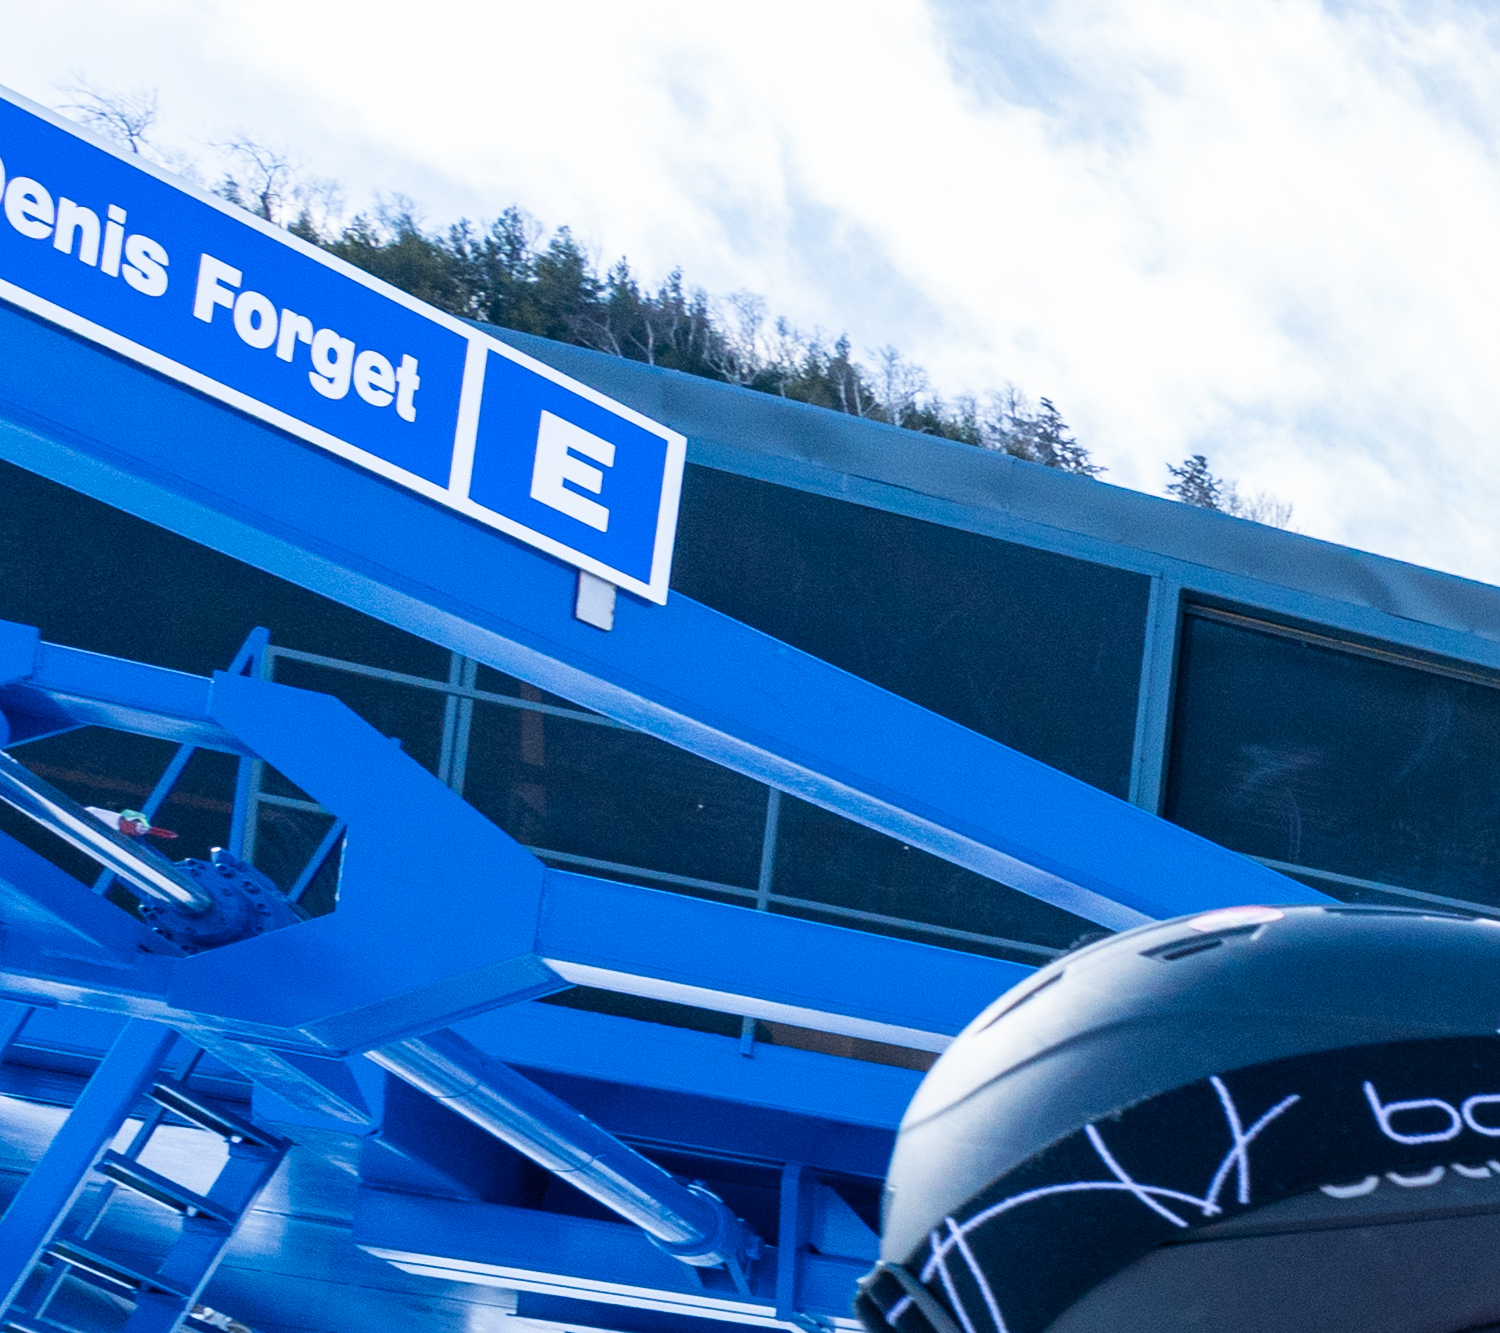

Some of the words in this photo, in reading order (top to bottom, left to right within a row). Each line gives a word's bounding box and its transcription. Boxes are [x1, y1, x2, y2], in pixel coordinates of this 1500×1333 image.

[0, 155, 170, 297] enis
[193, 252, 421, 423] Forget
[529, 409, 617, 533] E
